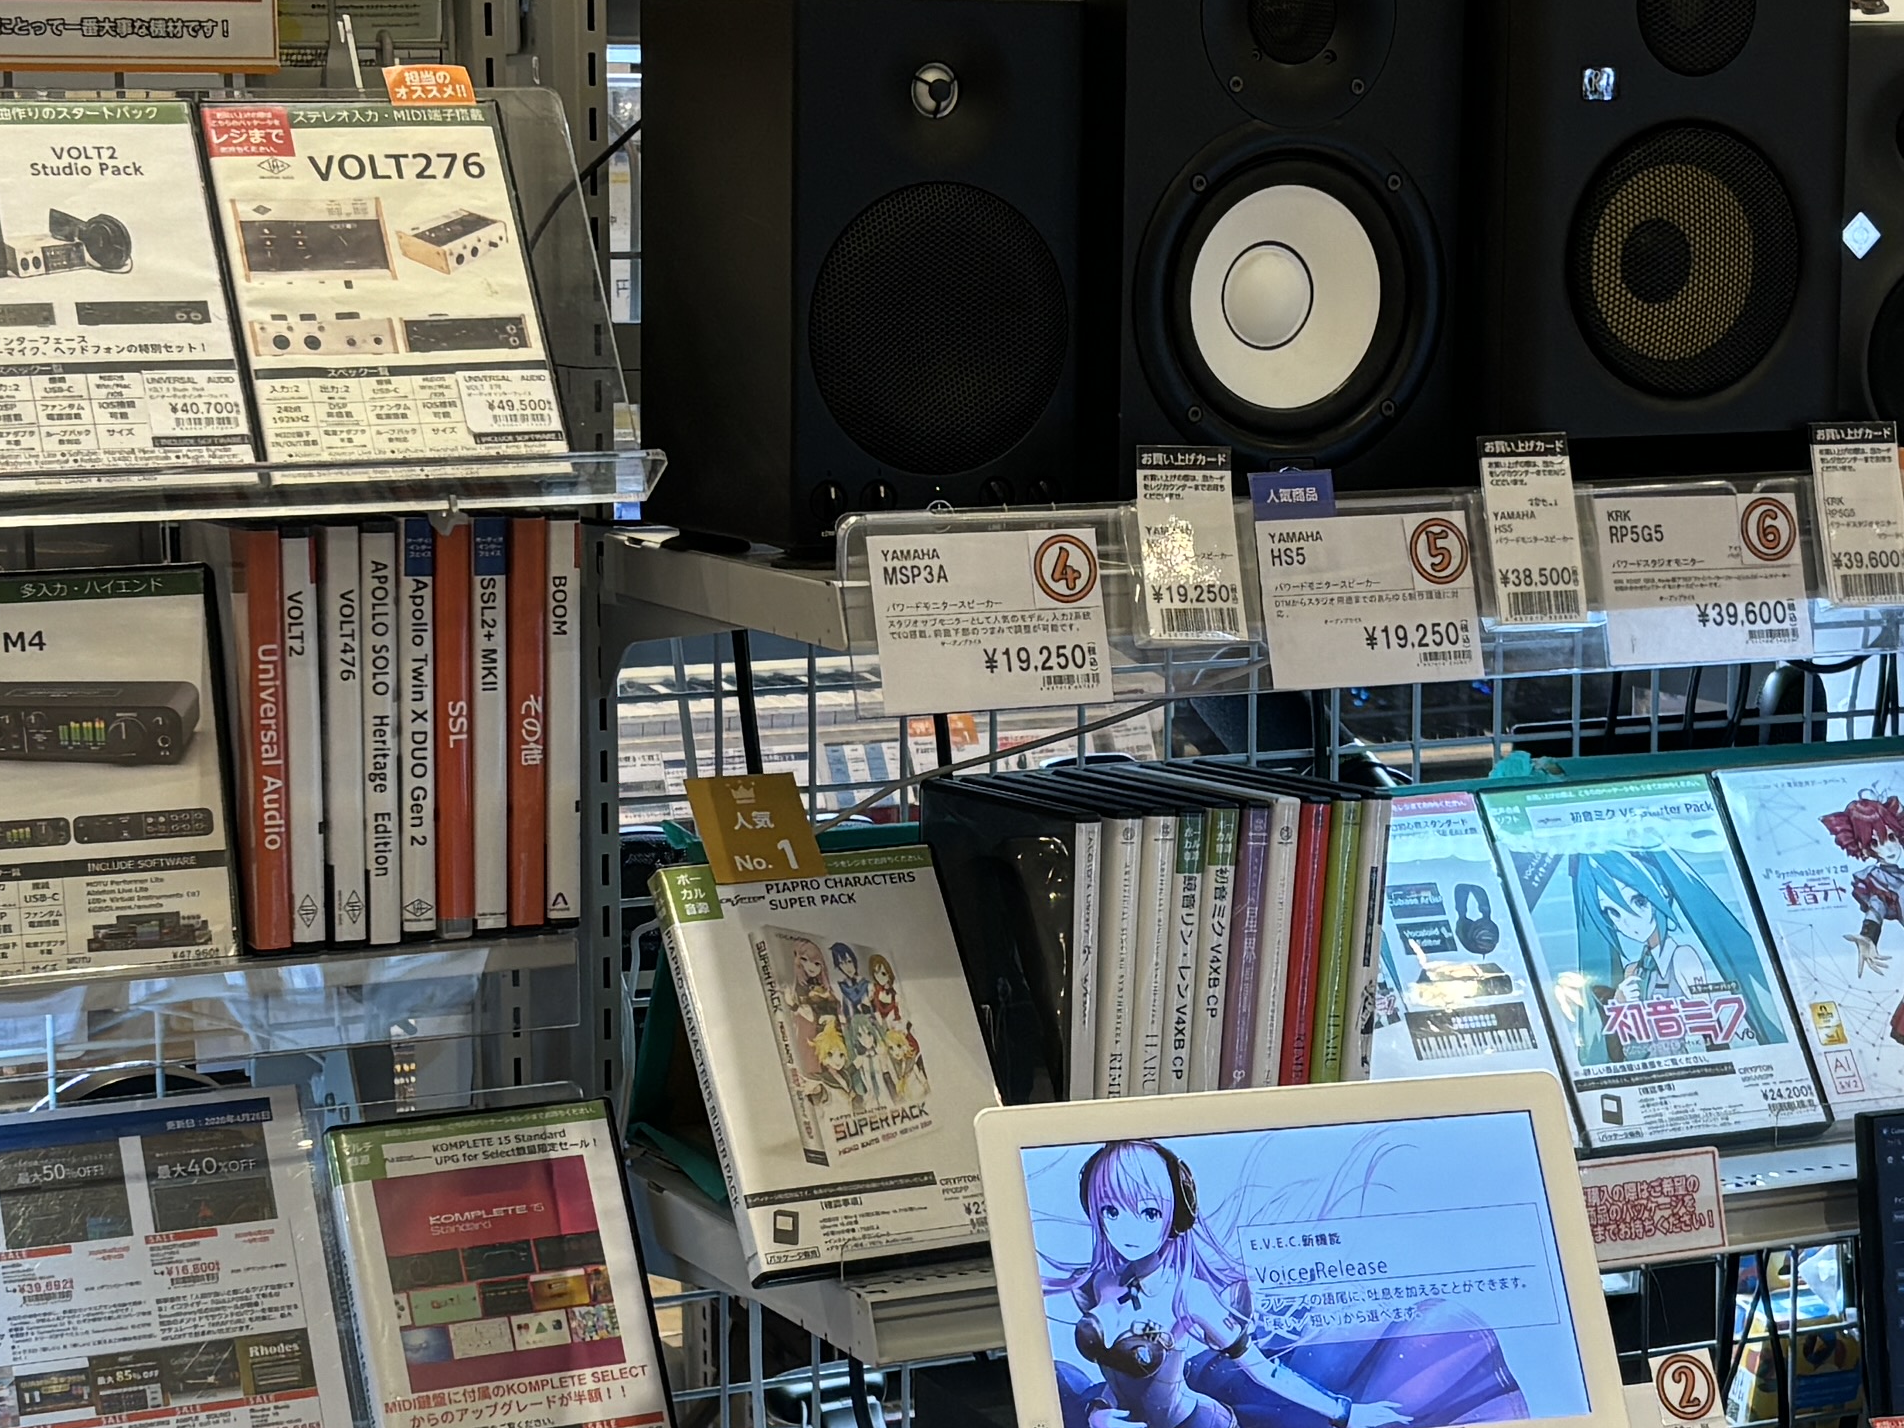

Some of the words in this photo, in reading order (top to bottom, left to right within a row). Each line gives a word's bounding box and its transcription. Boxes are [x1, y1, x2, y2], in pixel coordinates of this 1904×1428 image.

[50, 145, 118, 160] VOLT2
[29, 160, 88, 177] Studio
[94, 160, 144, 177] Pack
[307, 152, 487, 181] VOLT276
[1267, 530, 1324, 547] YAMAHA
[1609, 523, 1665, 544] RP5G5
[879, 547, 940, 566] YAMAHA
[1271, 546, 1308, 567] HS5
[18, 575, 164, 596] 多入力・ハイエンド
[882, 564, 949, 587] MSP3A
[1498, 568, 1574, 588] ¥38,500
[1150, 582, 1231, 605] ¥19,250
[1695, 602, 1789, 628] ¥39,600
[2, 631, 48, 654] M4
[1363, 622, 1459, 652] ¥19,250
[983, 643, 1089, 674] ¥19,250
[733, 811, 775, 831] 人気
[764, 879, 821, 895] PIAPRO
[824, 871, 916, 889] CHARACTERS
[428, 1204, 528, 1225] KOMPLETE
[1249, 1233, 1342, 1251] E.V.E.C.新機能
